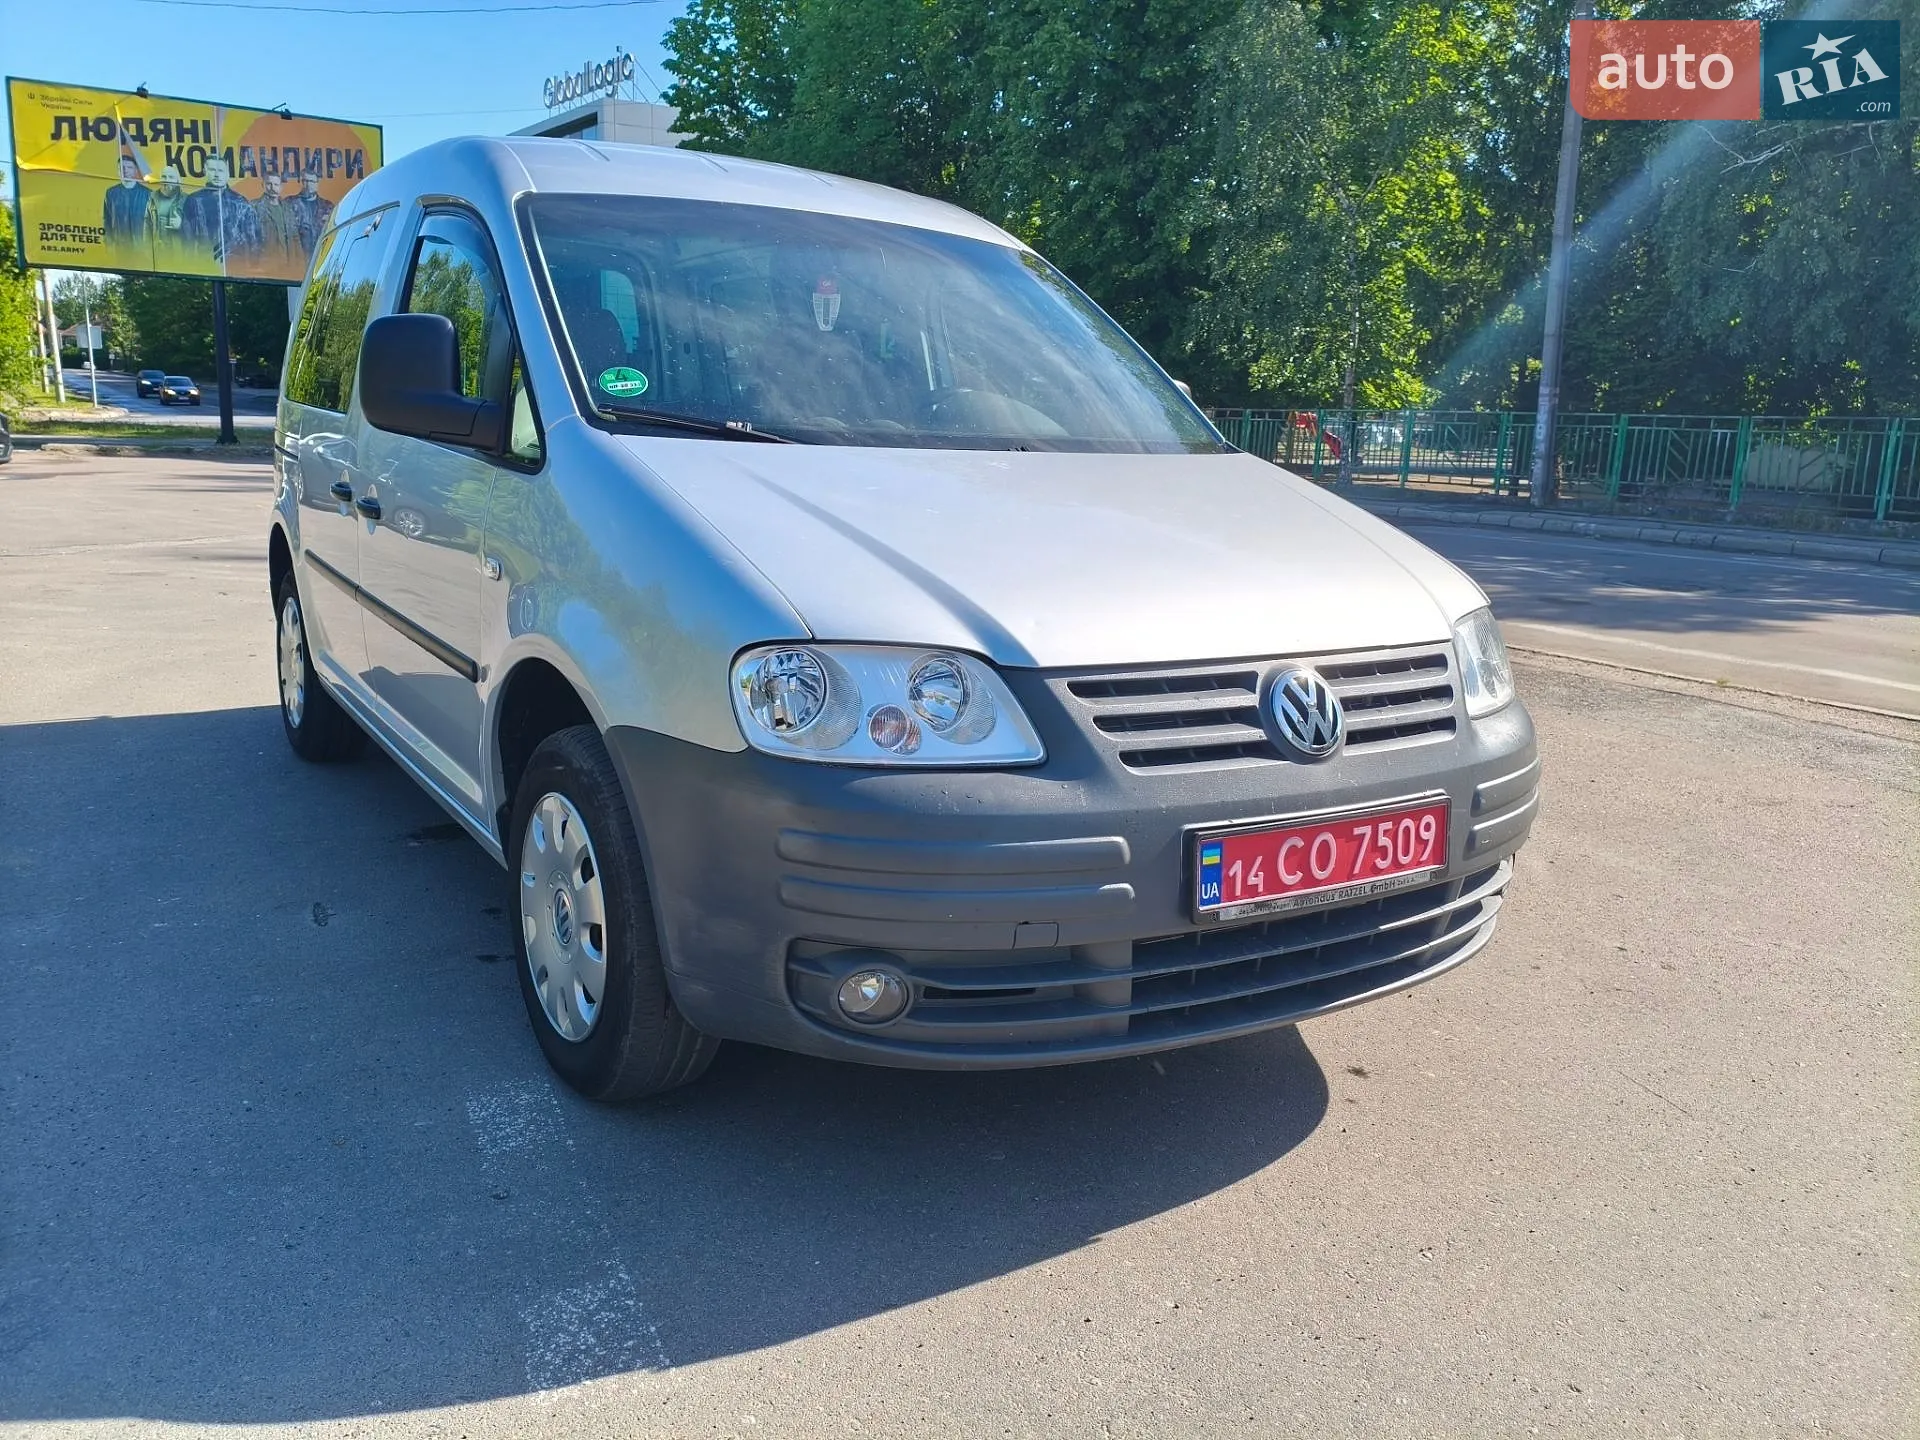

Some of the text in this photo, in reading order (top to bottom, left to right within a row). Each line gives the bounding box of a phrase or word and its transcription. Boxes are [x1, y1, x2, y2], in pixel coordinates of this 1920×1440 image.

[543, 45, 634, 108] GlobalLogic
[51, 115, 212, 147] ЛЮДЯНІ
[39, 222, 106, 236] ЗРОБЛЕНО
[40, 232, 101, 244] ДЛЯ ТЕБЕ
[1228, 814, 1437, 897] 14 CO 7509
[1201, 882, 1220, 900] UA
